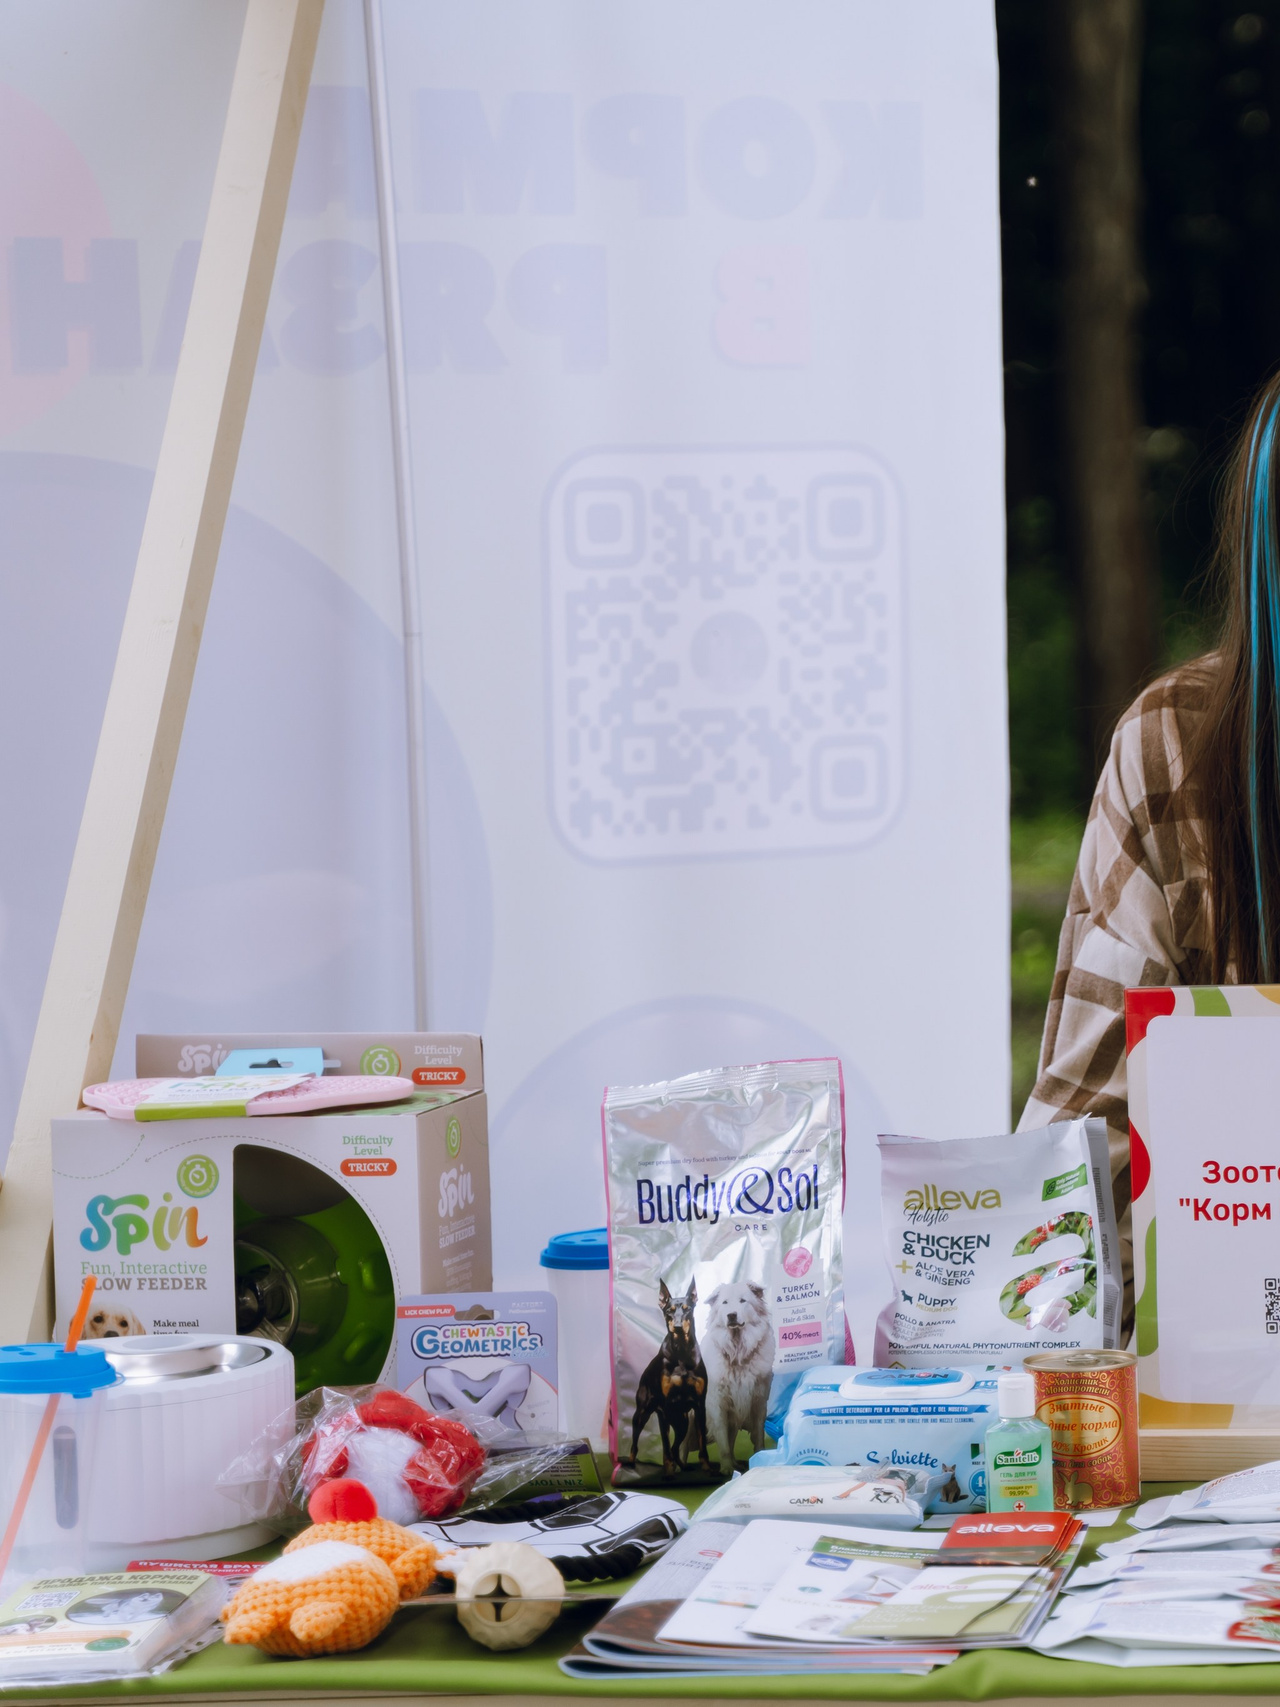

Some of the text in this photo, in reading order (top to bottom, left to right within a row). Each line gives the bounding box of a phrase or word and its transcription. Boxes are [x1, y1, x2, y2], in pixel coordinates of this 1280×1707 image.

[414, 1044, 463, 1057] Difficulty
[424, 1054, 453, 1065] Level
[418, 1071, 459, 1082] TRICKY
[342, 1134, 394, 1148] Difficulty
[353, 1145, 383, 1156] Level
[348, 1162, 390, 1173] TRICKY
[438, 1163, 475, 1218] Spin
[903, 1183, 1002, 1210] alleva
[903, 1202, 953, 1227] Holistic
[1179, 1197, 1272, 1227] "Корм
[79, 1191, 208, 1256] Spin
[902, 1230, 990, 1250] CHICKEN
[902, 1243, 976, 1265] & DUCK
[80, 1261, 208, 1276] Fun, Interactive
[915, 1261, 975, 1278] ALOE VERA
[137, 1277, 208, 1290] FEEDER
[915, 1269, 971, 1286] & GINSENG
[782, 1283, 815, 1293] TURKEY
[785, 1290, 820, 1302] SALMON
[917, 1293, 957, 1307] PUPPY
[915, 1303, 942, 1312] MEDIUM
[153, 1319, 199, 1328] Make meal
[802, 1314, 815, 1322] Skin
[894, 1312, 917, 1326] POLLO
[925, 1318, 956, 1326] ANATRA
[416, 1327, 538, 1355] GEOMETRICS
[933, 1341, 971, 1349] NATURAL
[973, 1341, 1041, 1349] PHYTONUTRIENT
[1042, 1340, 1081, 1348] COMPLEX
[867, 1371, 949, 1380] CAMON
[1054, 1377, 1100, 1386] Холистик
[1045, 1385, 1111, 1396] Монопротеин
[1049, 1402, 1106, 1414] Знатные
[1080, 1418, 1118, 1432] корма
[1073, 1436, 1109, 1453] Кролик
[866, 1450, 939, 1468] Slviette
[996, 1452, 1040, 1464] Sanitelle
[1087, 1452, 1113, 1467] собак
[790, 1496, 824, 1505] CAMON
[956, 1522, 1055, 1534] alleva
[138, 1560, 218, 1570] ПУШИСТАЯ
[37, 1573, 200, 1586] ПРОДАЖА КОРМОВ
